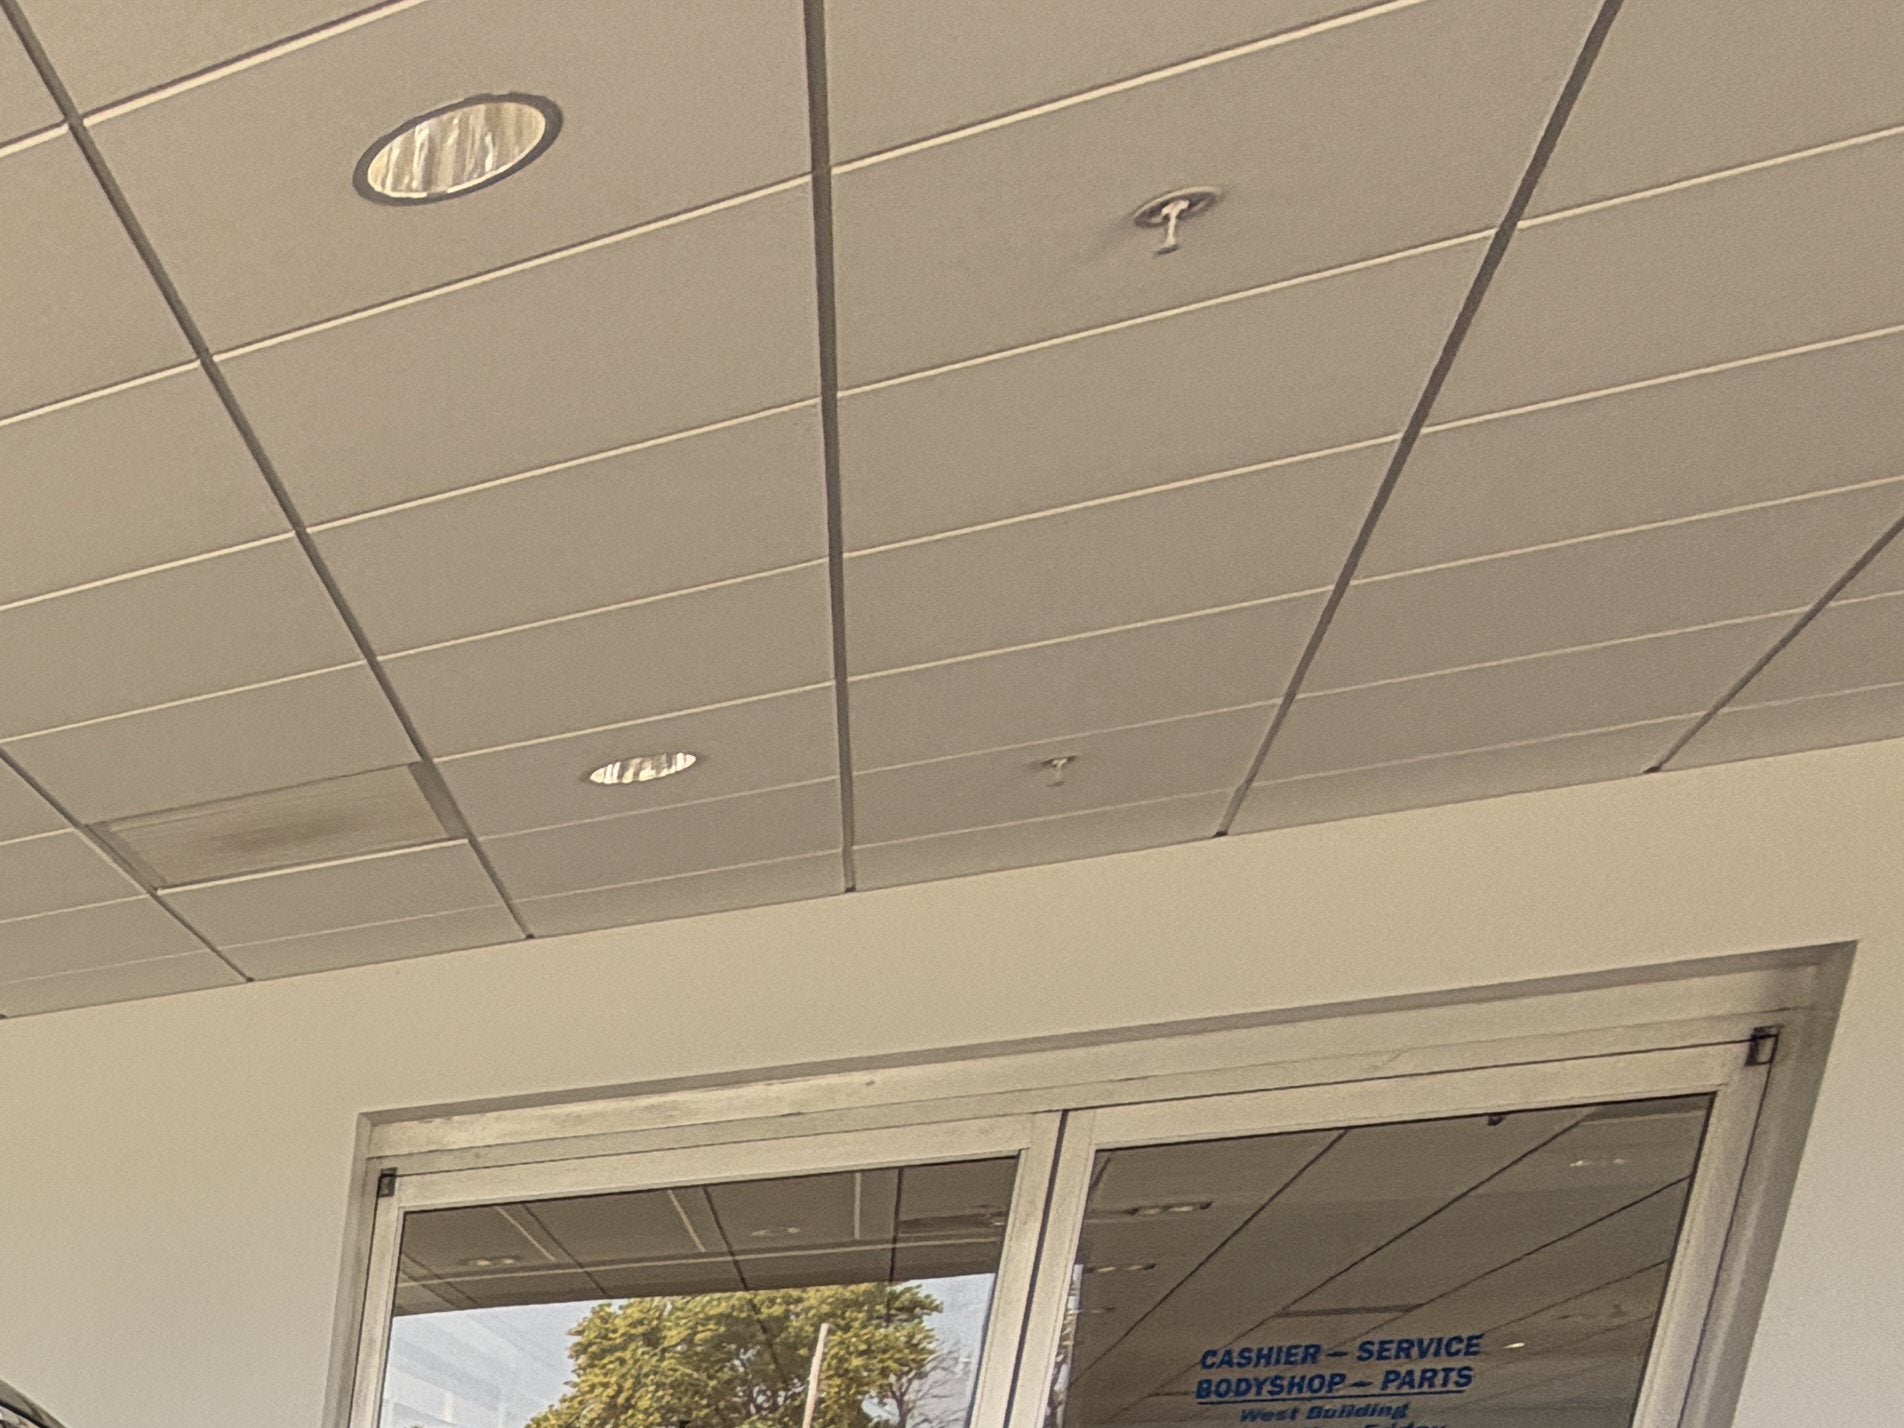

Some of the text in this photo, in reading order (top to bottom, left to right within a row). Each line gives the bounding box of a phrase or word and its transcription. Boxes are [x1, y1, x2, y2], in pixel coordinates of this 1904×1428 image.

[1199, 1343, 1322, 1370] CASHIER
[1356, 1333, 1485, 1363] SERVICE
[1195, 1372, 1347, 1400] BODYSHOP
[1380, 1366, 1474, 1392] PARTS
[1240, 1405, 1298, 1423] West
